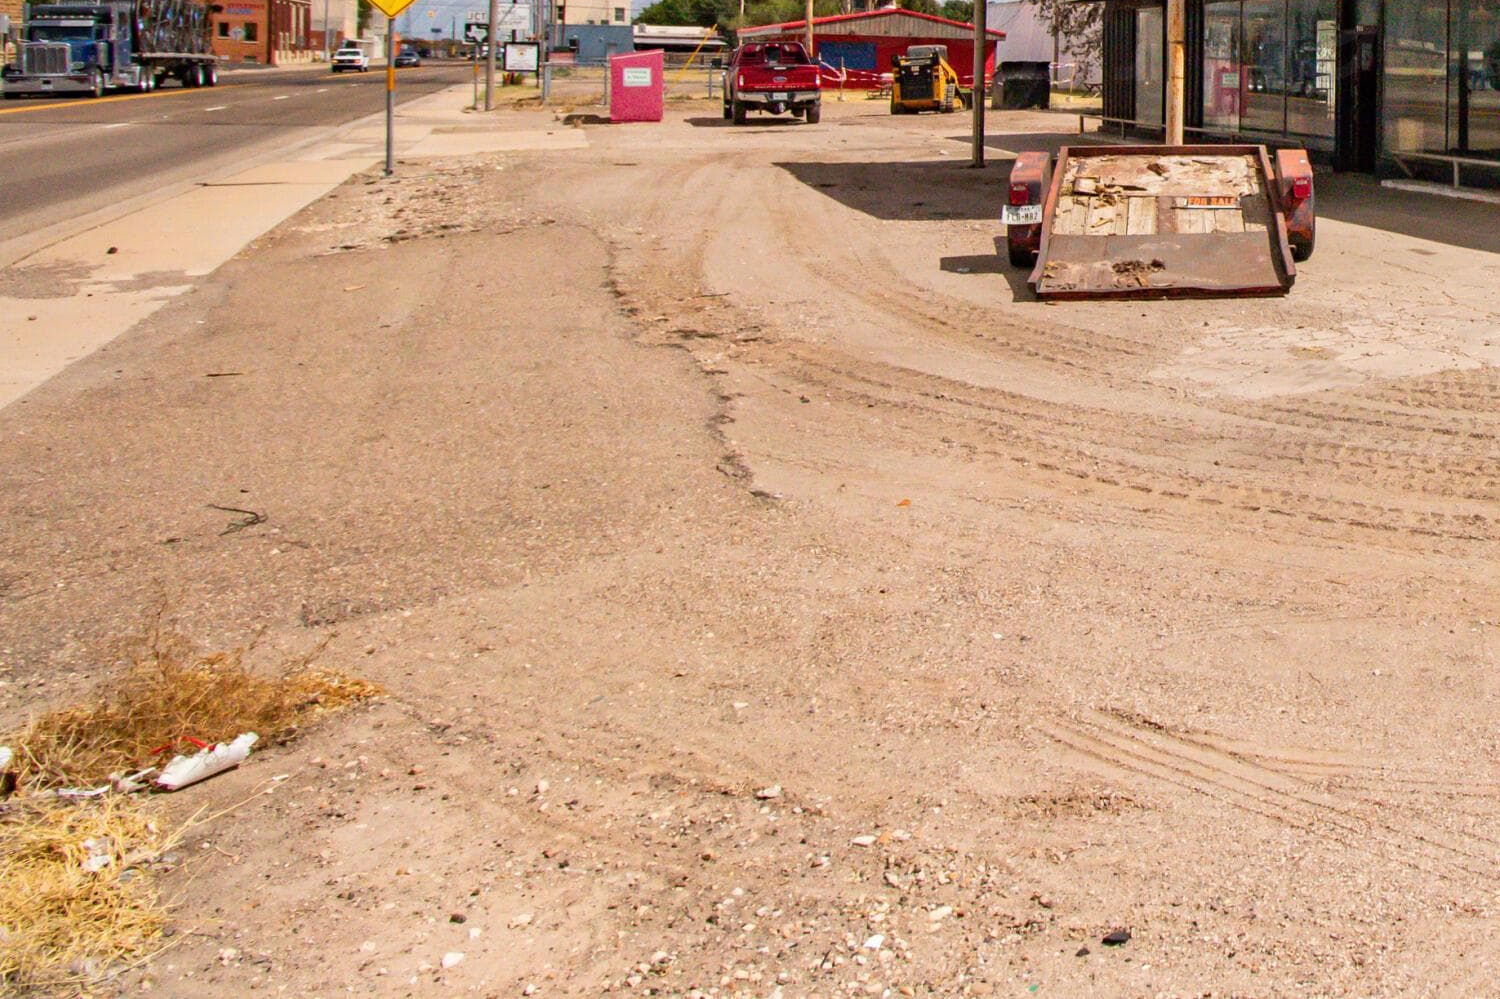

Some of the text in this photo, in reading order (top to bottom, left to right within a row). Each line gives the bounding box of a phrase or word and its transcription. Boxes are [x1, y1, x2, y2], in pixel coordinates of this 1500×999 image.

[467, 12, 488, 22] JCT
[1188, 197, 1236, 205] FOR SALE
